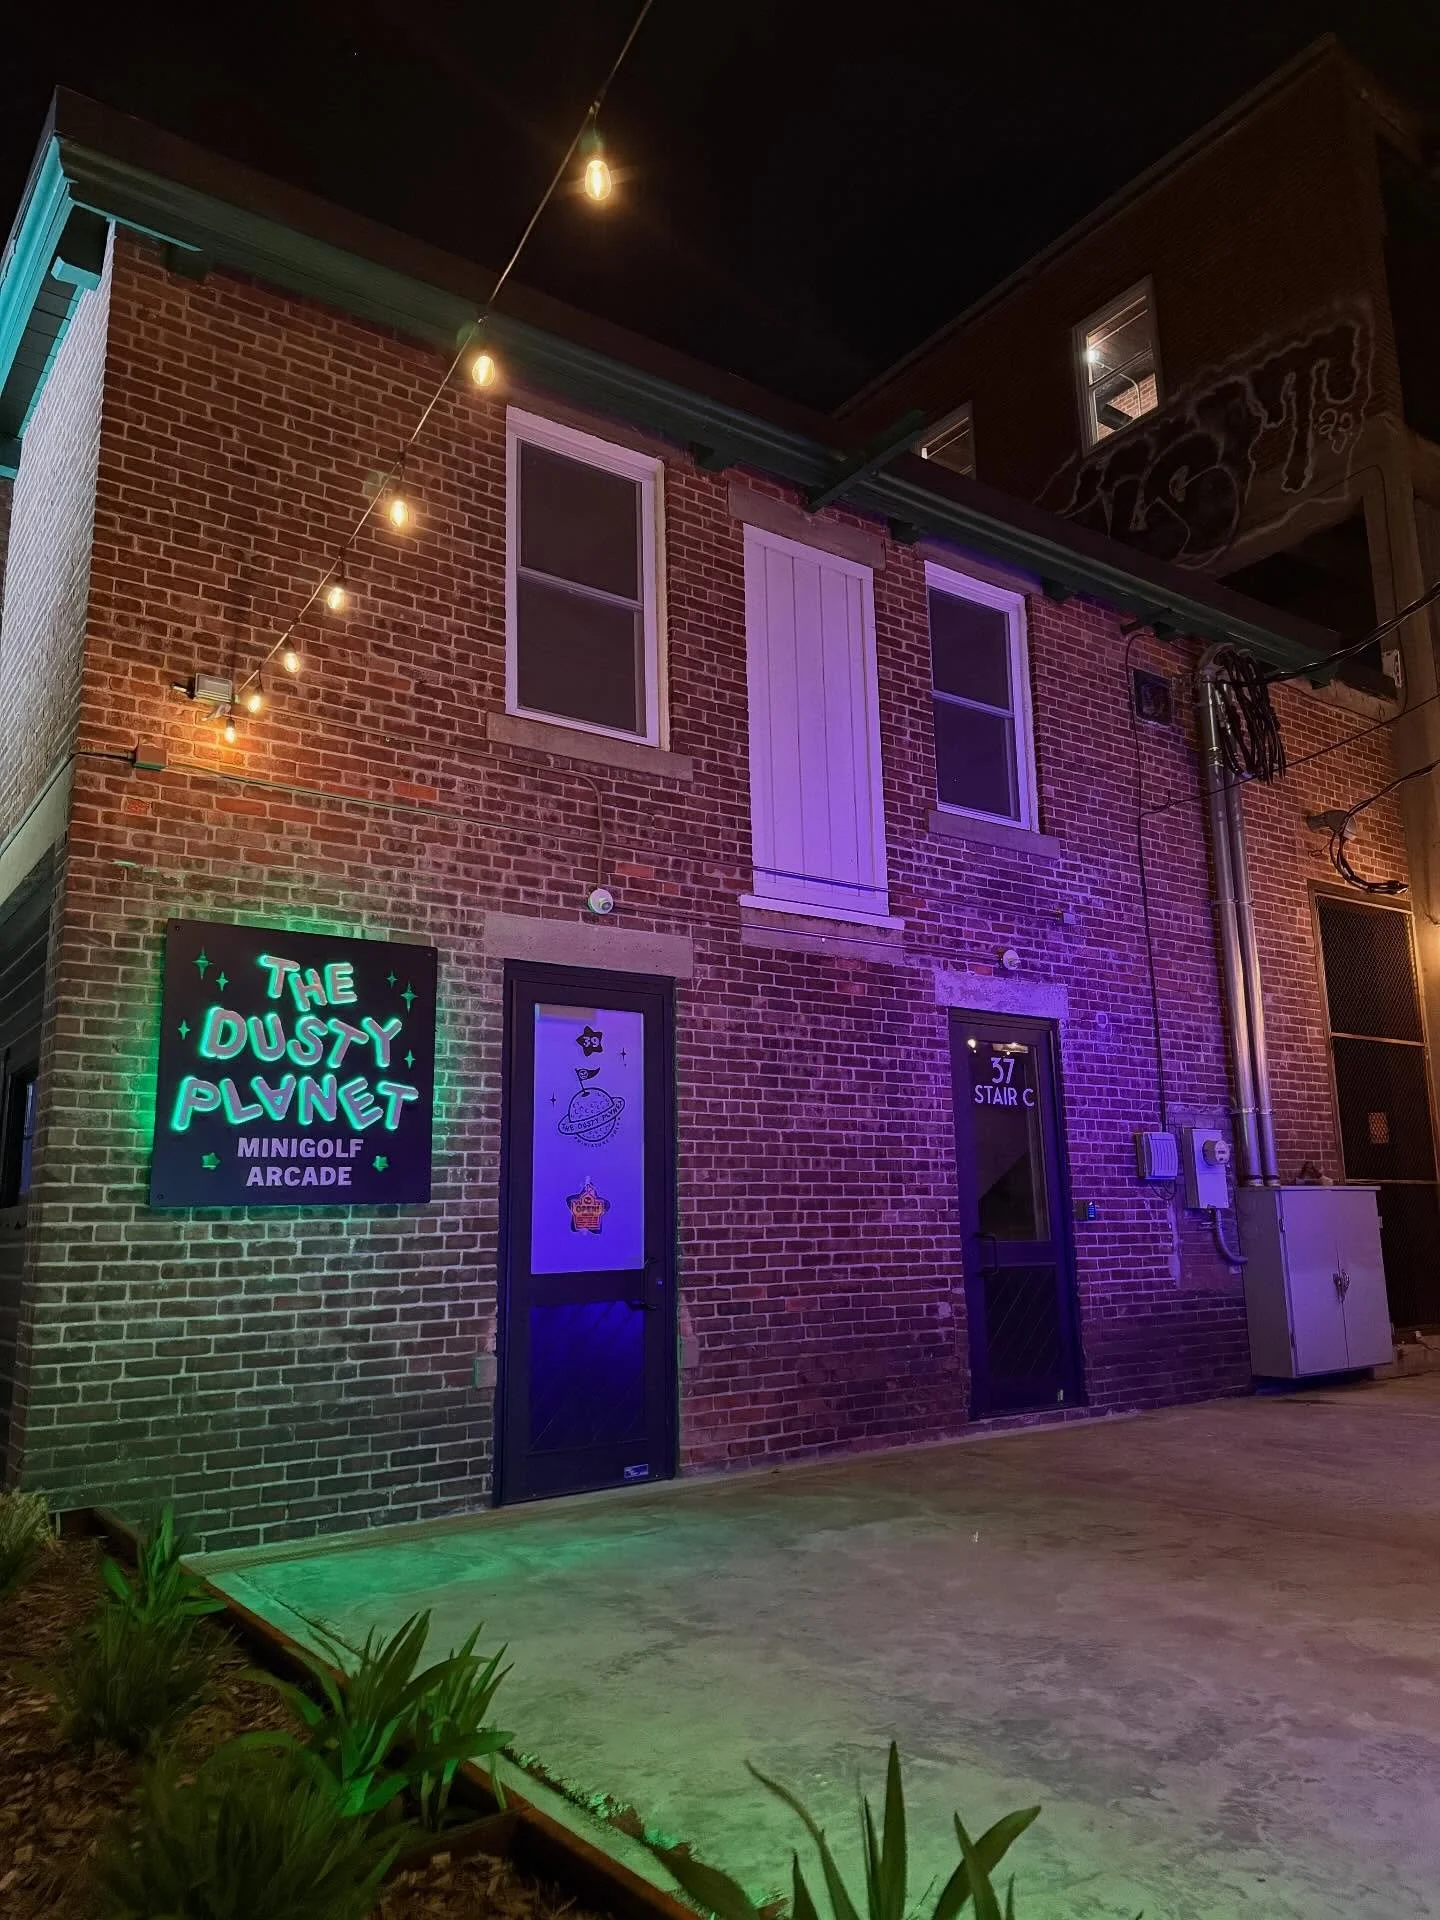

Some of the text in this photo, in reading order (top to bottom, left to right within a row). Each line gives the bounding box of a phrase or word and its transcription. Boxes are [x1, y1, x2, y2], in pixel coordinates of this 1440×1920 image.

[258, 955, 358, 1011] THE
[200, 1006, 402, 1068] DUSTY
[583, 1036, 599, 1048] 39
[990, 1057, 1015, 1084] 37
[172, 1073, 419, 1131] PLANET
[974, 1085, 1035, 1107] STAIR C
[237, 1137, 363, 1158] MINIGOLF
[246, 1166, 353, 1187] ARCADE
